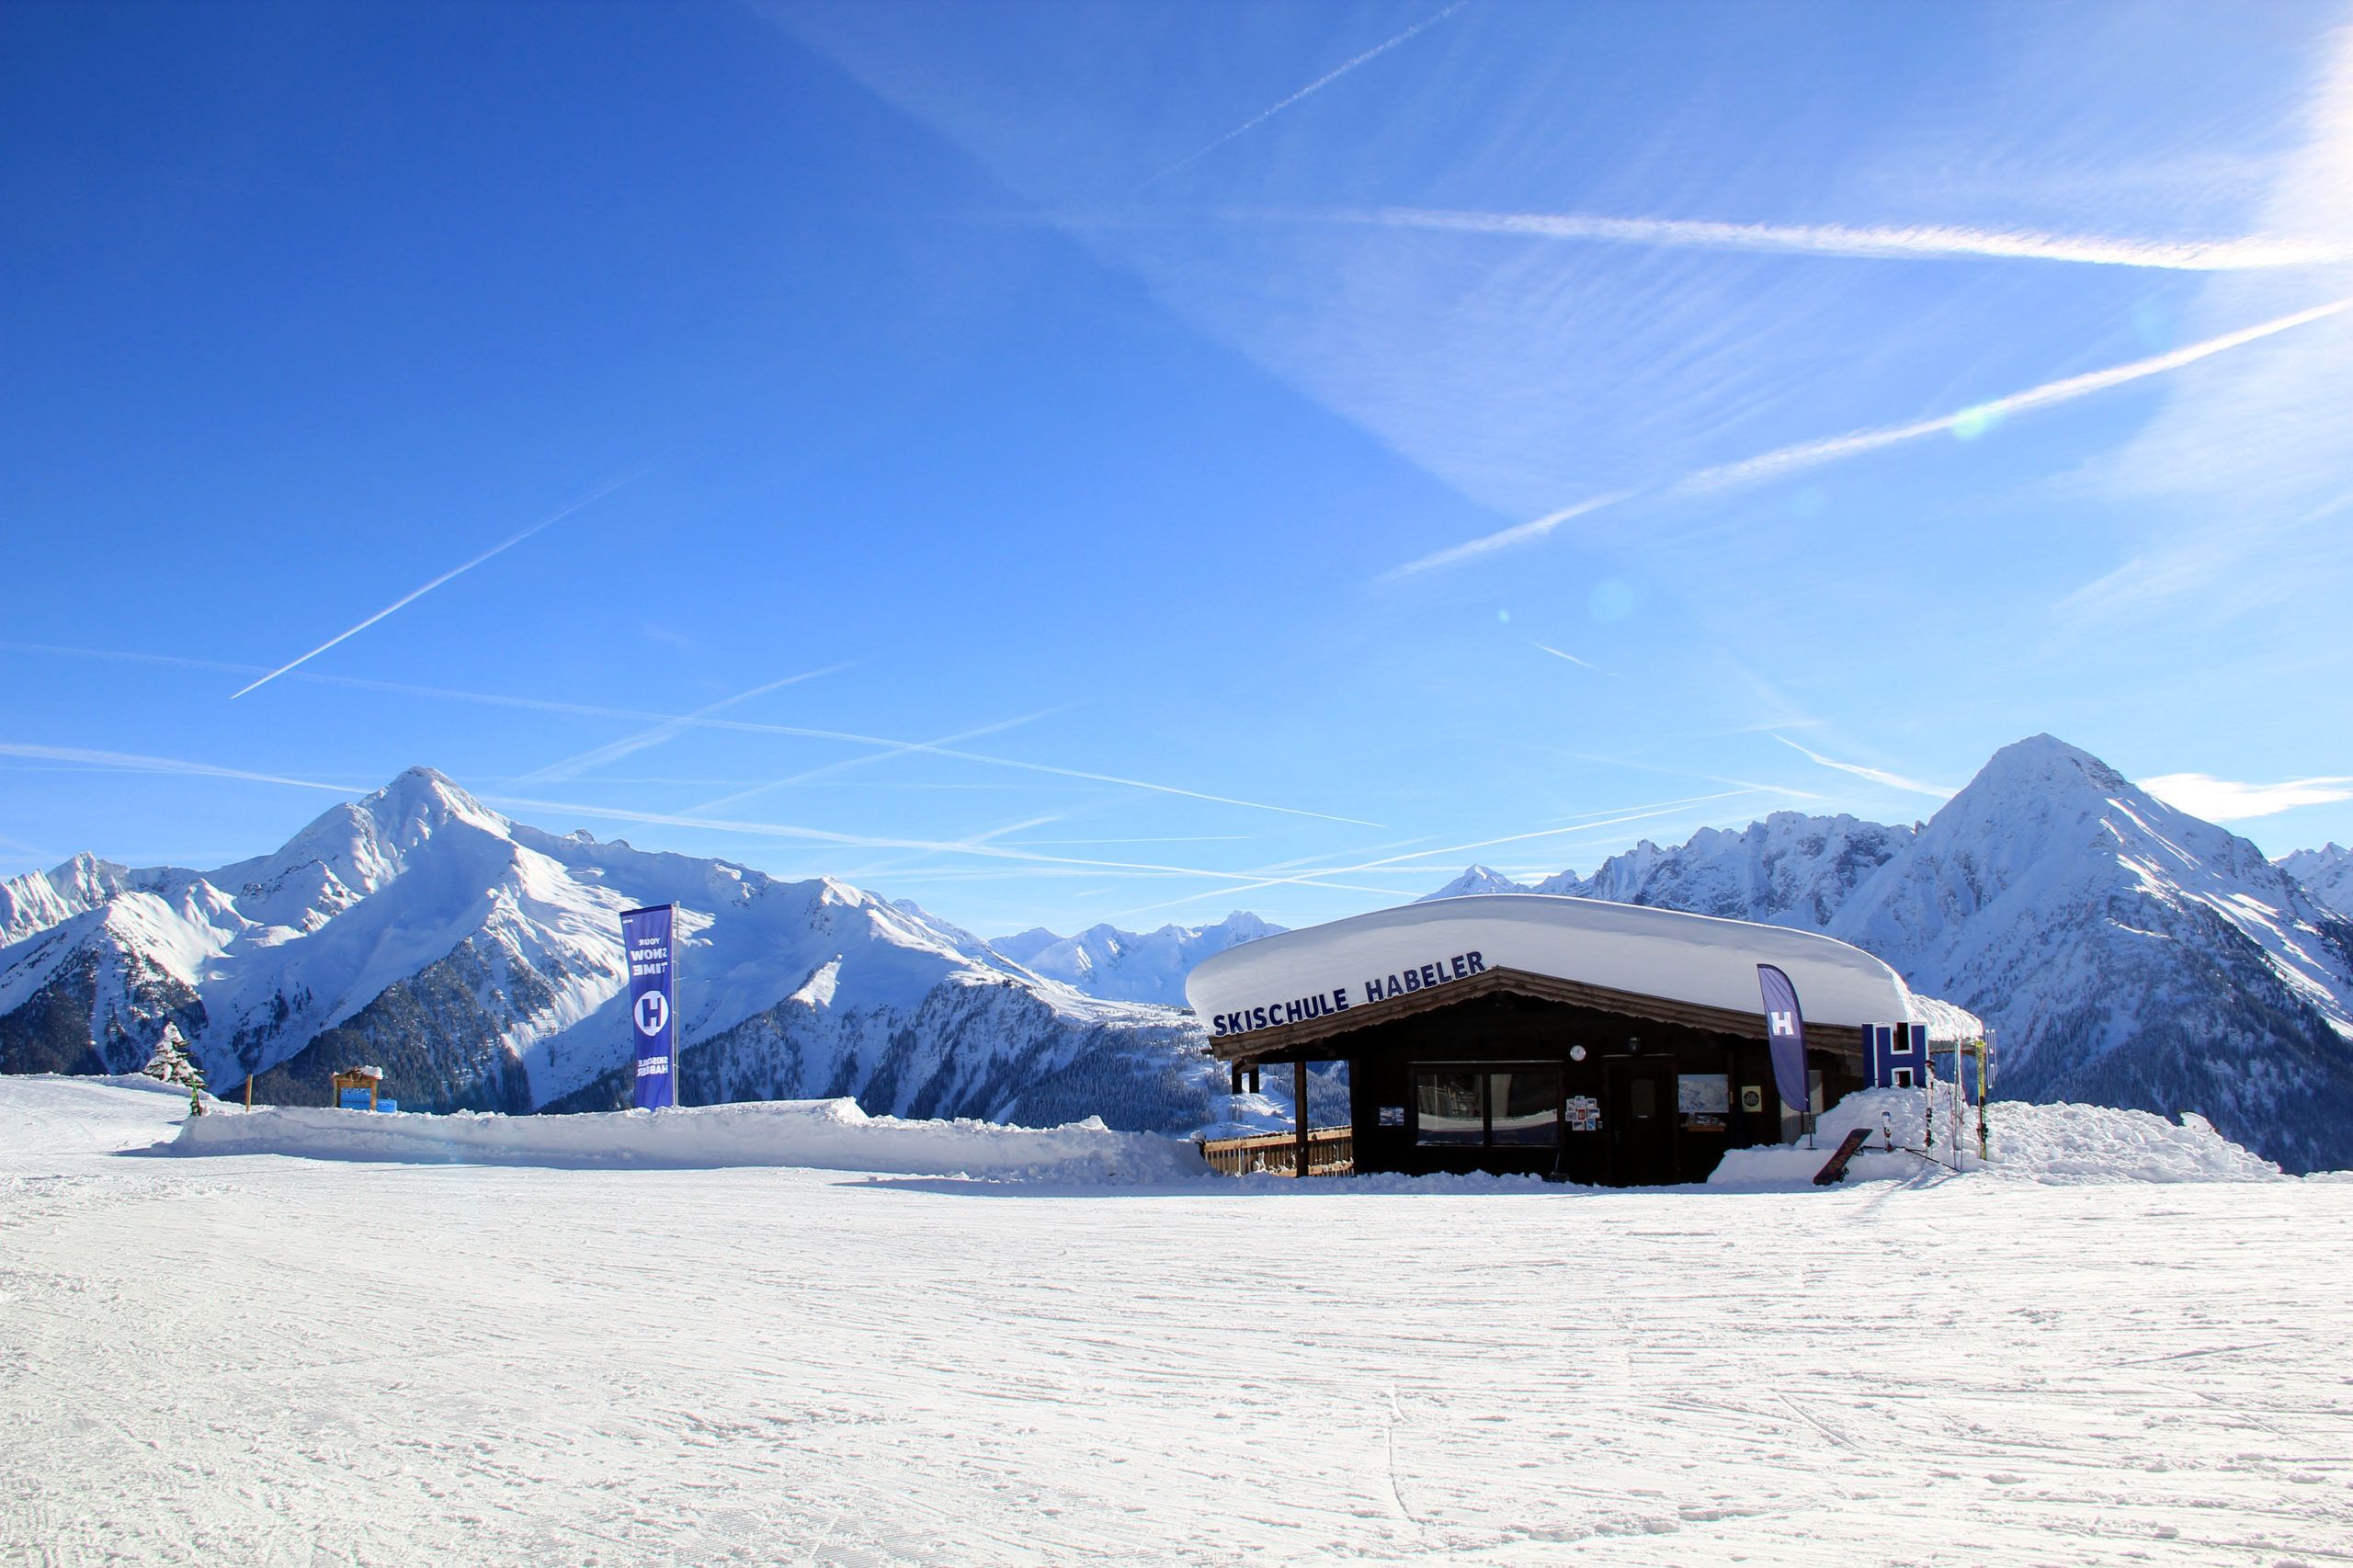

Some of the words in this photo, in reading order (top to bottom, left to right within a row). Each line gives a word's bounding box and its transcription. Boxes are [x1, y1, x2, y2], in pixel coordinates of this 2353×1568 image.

[642, 996, 662, 1028] H
[1213, 987, 1350, 1037] SKISCHULE
[1365, 950, 1486, 1004] HABELER
[1770, 1011, 1794, 1036] H
[1872, 1022, 1928, 1088] H
